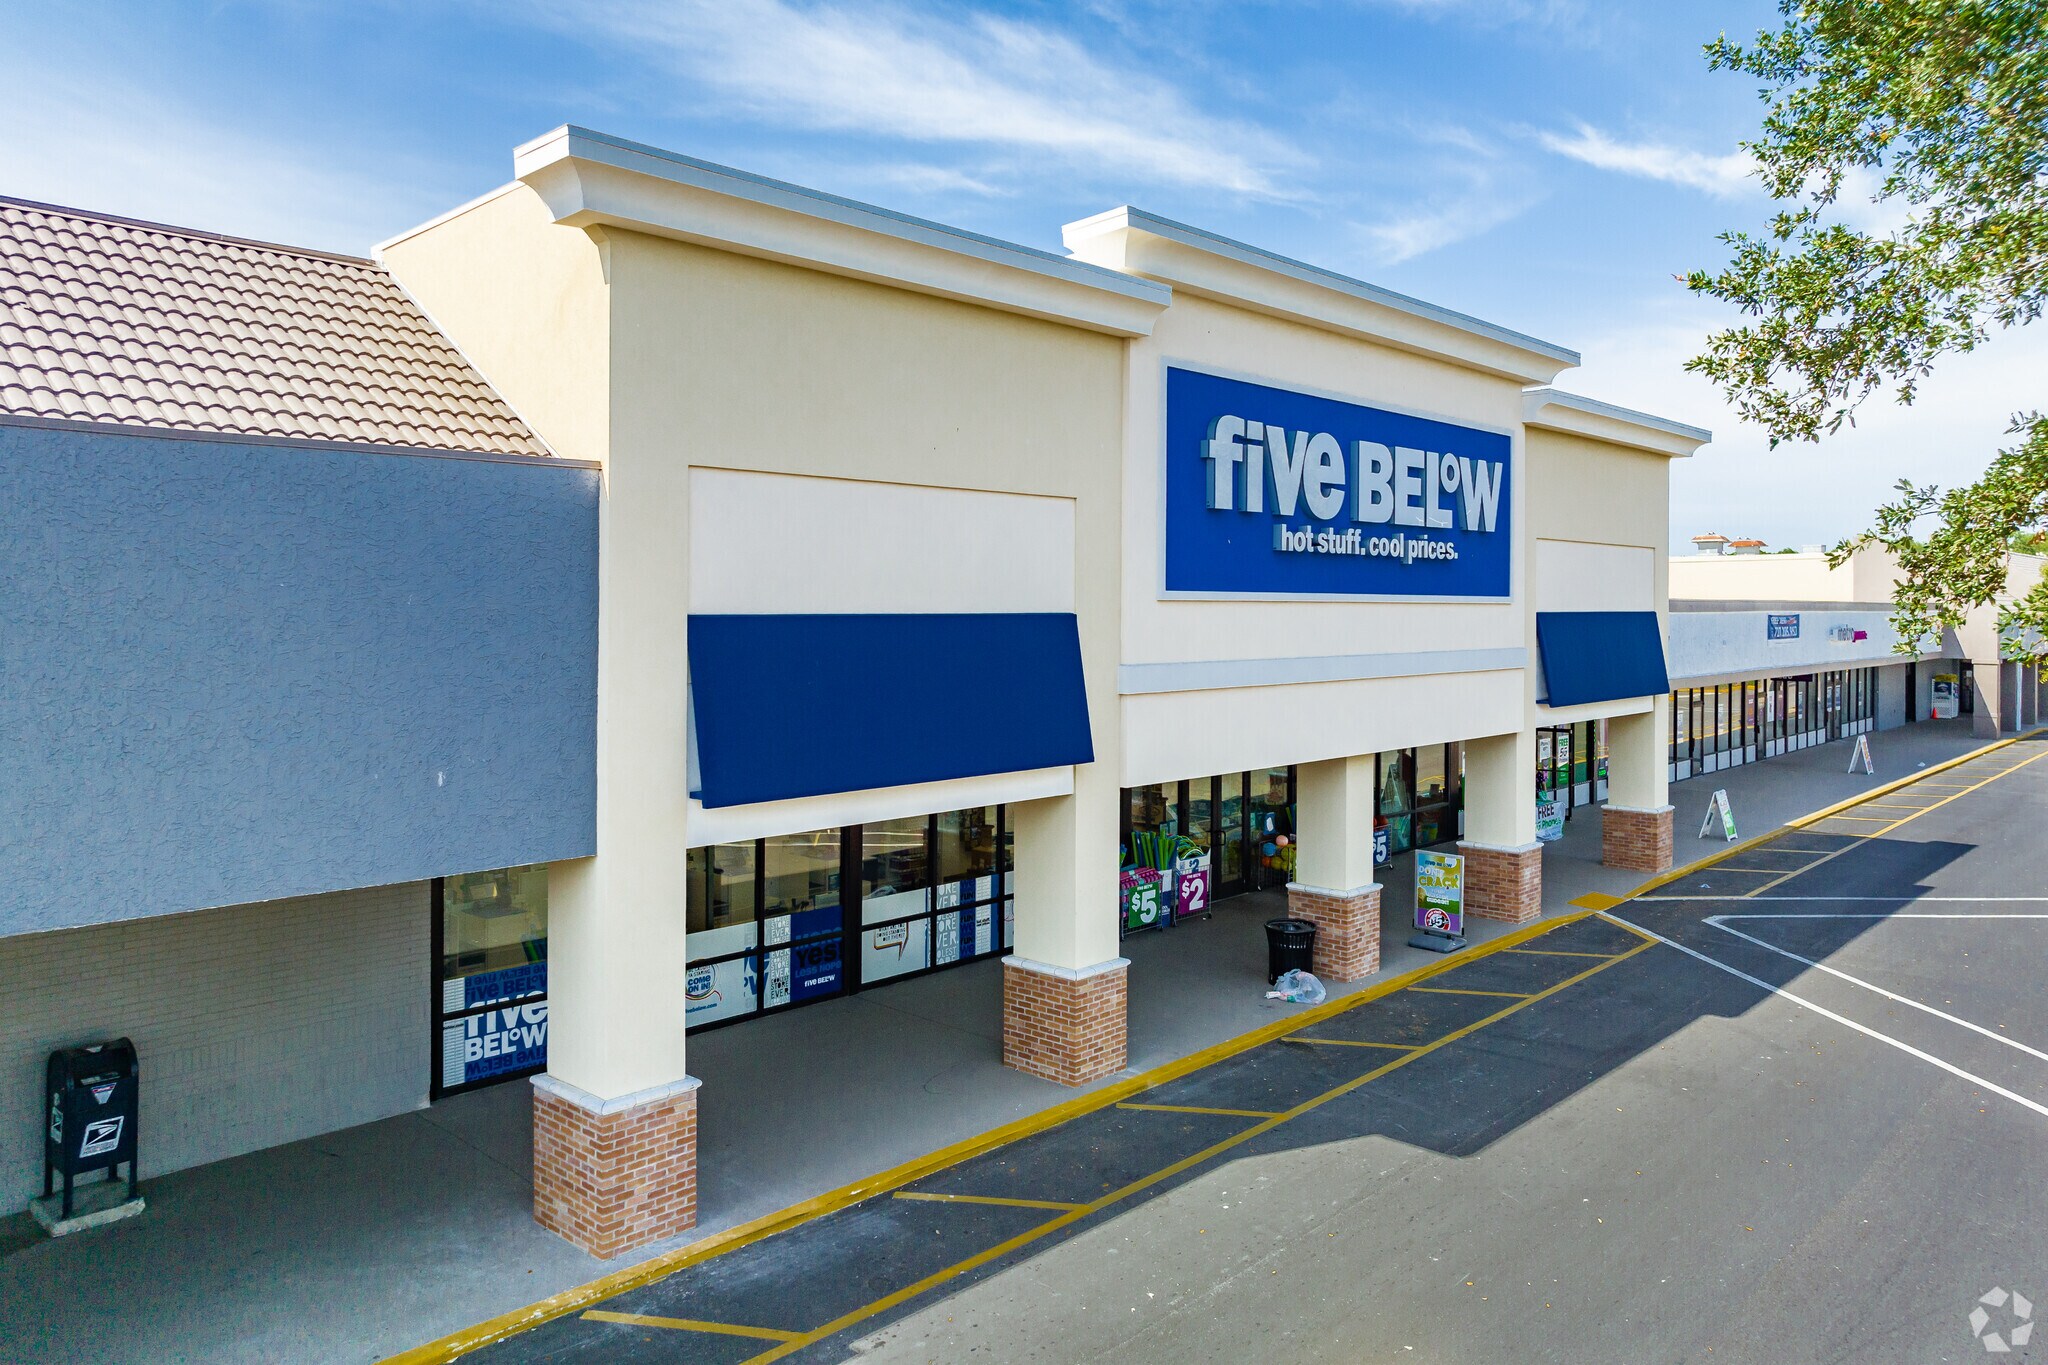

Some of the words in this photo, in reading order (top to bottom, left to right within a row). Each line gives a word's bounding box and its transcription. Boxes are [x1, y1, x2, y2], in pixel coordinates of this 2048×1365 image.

[1201, 415, 1346, 520] five
[1276, 524, 1313, 553] hot
[1315, 527, 1366, 556] stuff.
[1369, 533, 1404, 559] cool
[1405, 535, 1459, 565] prices.
[1537, 804, 1554, 819] FREE
[1182, 878, 1204, 911] $2
[1418, 875, 1459, 889] CRACK
[1131, 889, 1157, 923] $5
[688, 984, 699, 993] ON
[465, 1022, 547, 1063] BELOW
